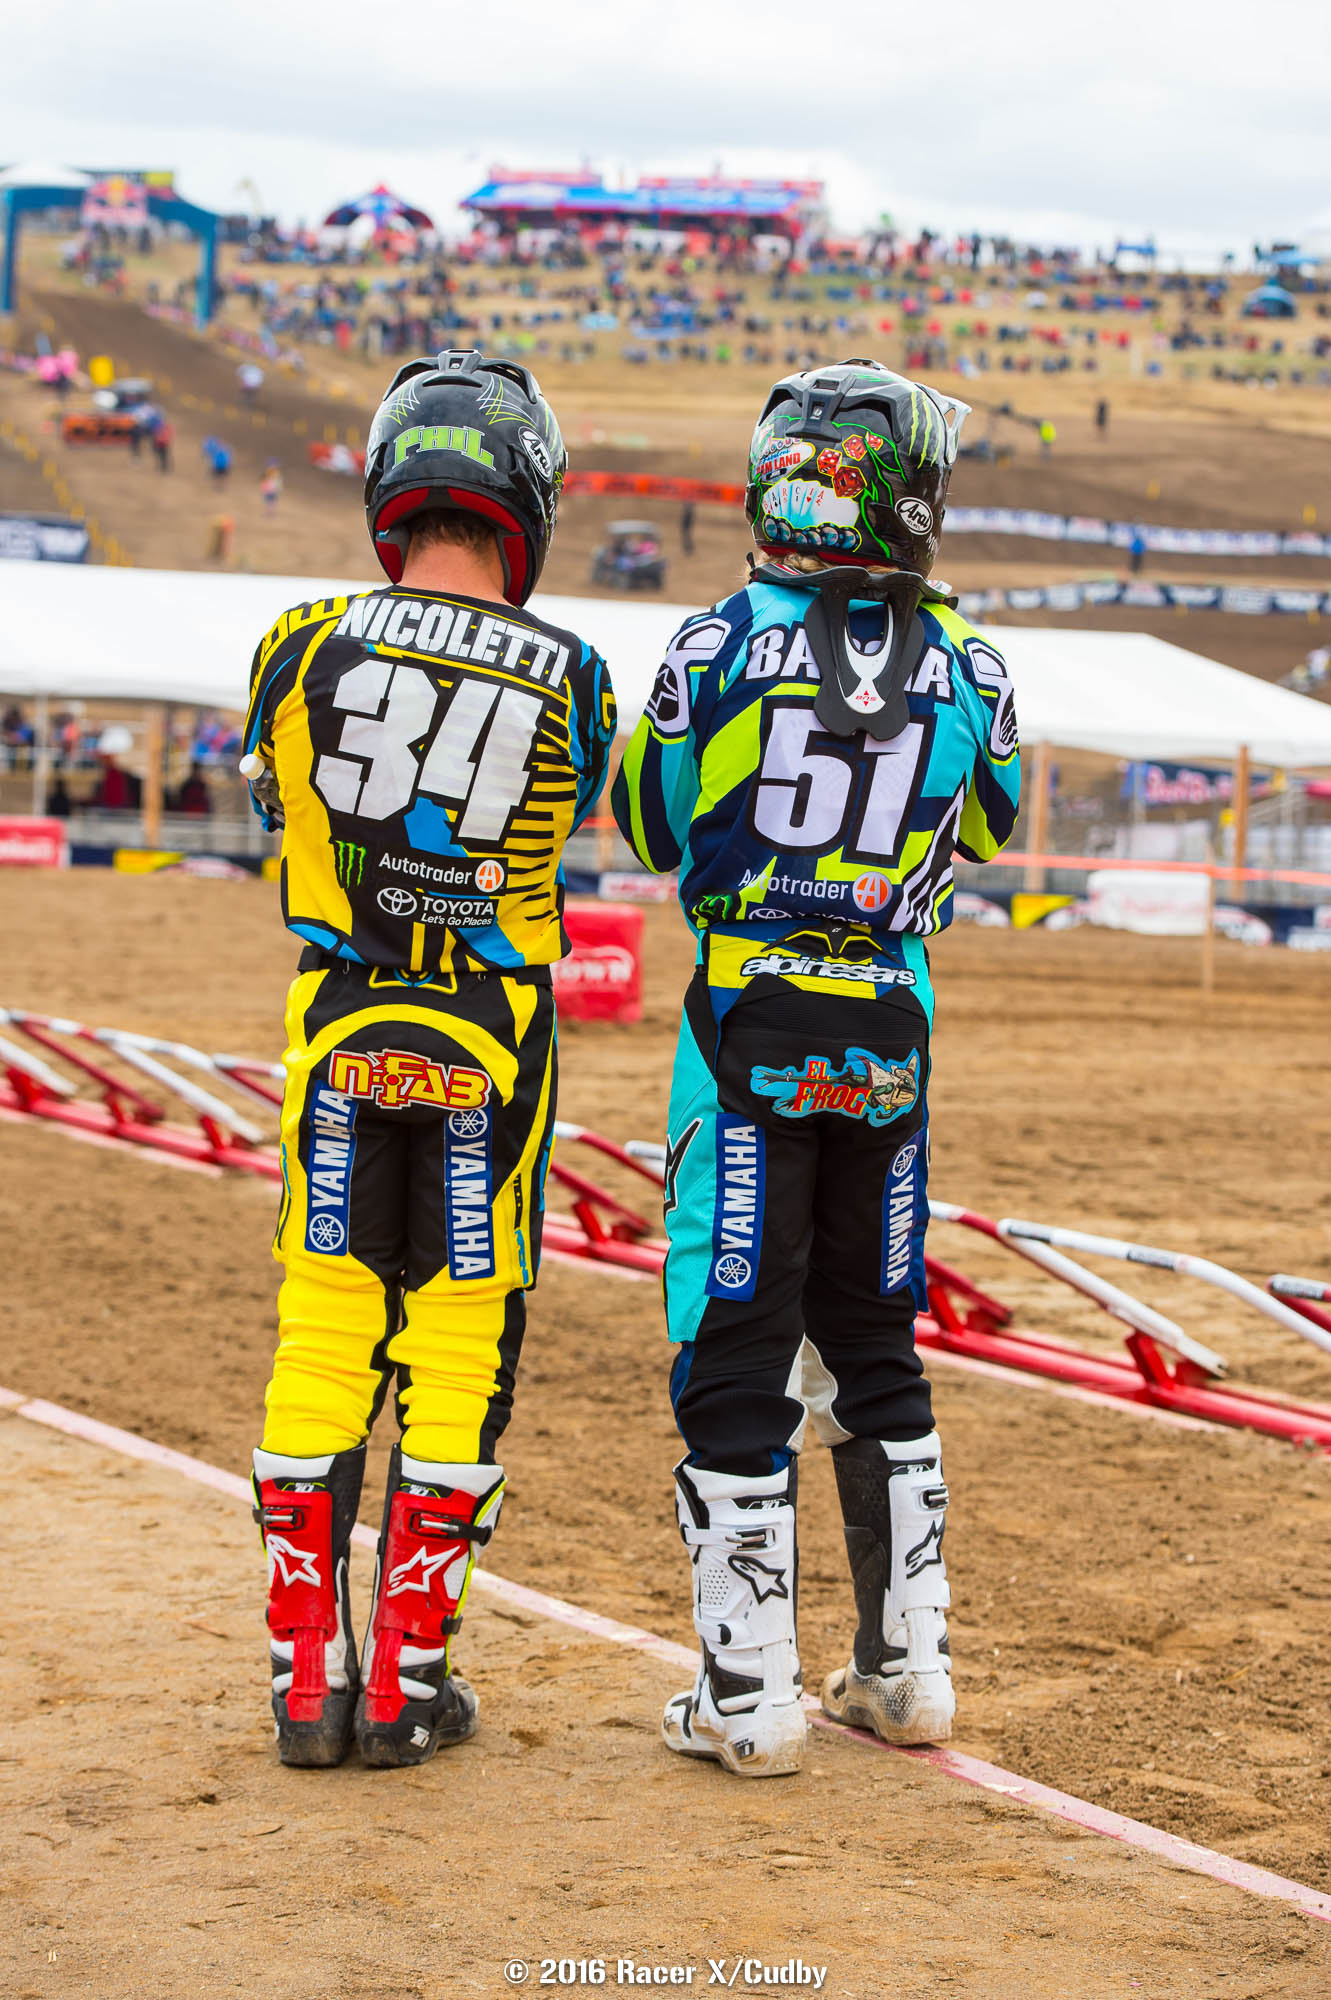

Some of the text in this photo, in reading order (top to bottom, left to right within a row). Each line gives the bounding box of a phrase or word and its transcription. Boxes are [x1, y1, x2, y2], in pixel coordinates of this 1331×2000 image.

[392, 425, 497, 471] PHIL
[773, 452, 801, 471] LAND
[899, 503, 930, 528] Arai
[333, 597, 571, 689] NICOLETTI
[314, 658, 545, 842] 34
[753, 707, 925, 856] 51
[378, 852, 472, 886] Autotrader
[738, 868, 849, 901] Autotrader
[420, 912, 493, 927] Let's Go Places
[421, 895, 495, 916] TOYOTA
[741, 953, 917, 987] alpinestars
[807, 1060, 830, 1081] EL
[791, 1081, 873, 1117] FROG
[311, 1087, 353, 1208] YAMAHA
[720, 1124, 757, 1251] YAMAHA
[450, 1140, 491, 1277] YAMAHA
[886, 1172, 915, 1289] YAMAHA
